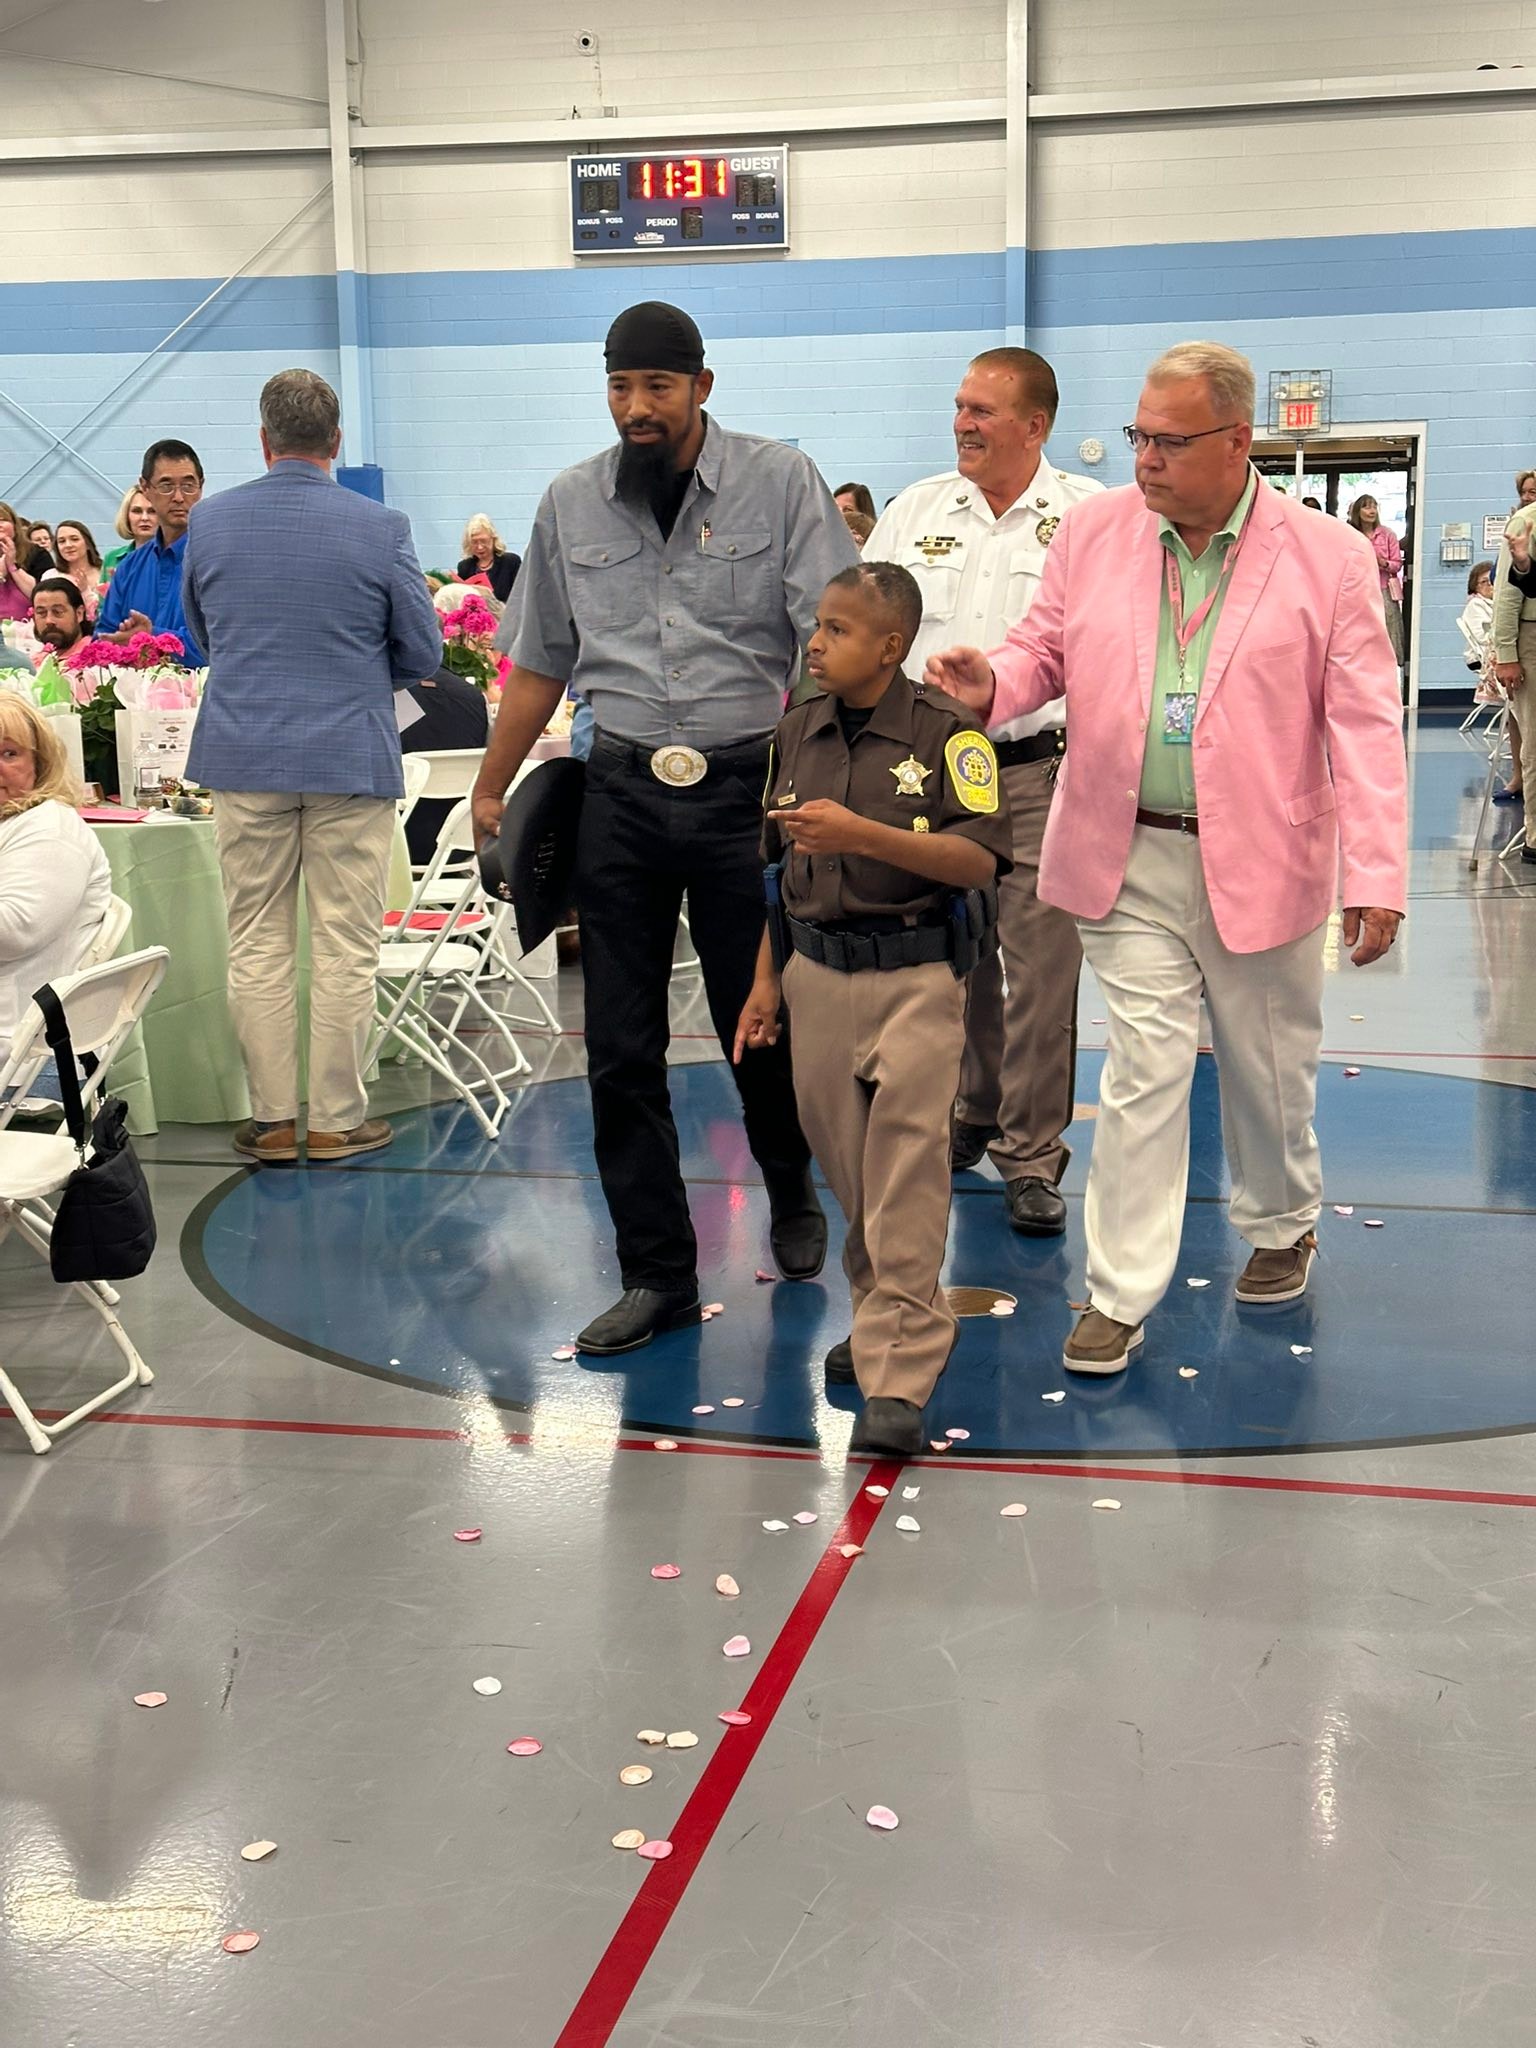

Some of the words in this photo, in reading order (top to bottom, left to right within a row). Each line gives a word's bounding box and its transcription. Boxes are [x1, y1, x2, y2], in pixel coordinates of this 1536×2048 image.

[577, 163, 621, 178] HOME
[730, 156, 780, 172] GUEST
[641, 159, 726, 199] 11:31
[646, 218, 678, 227] PERIOD
[1287, 403, 1315, 426] EXIT
